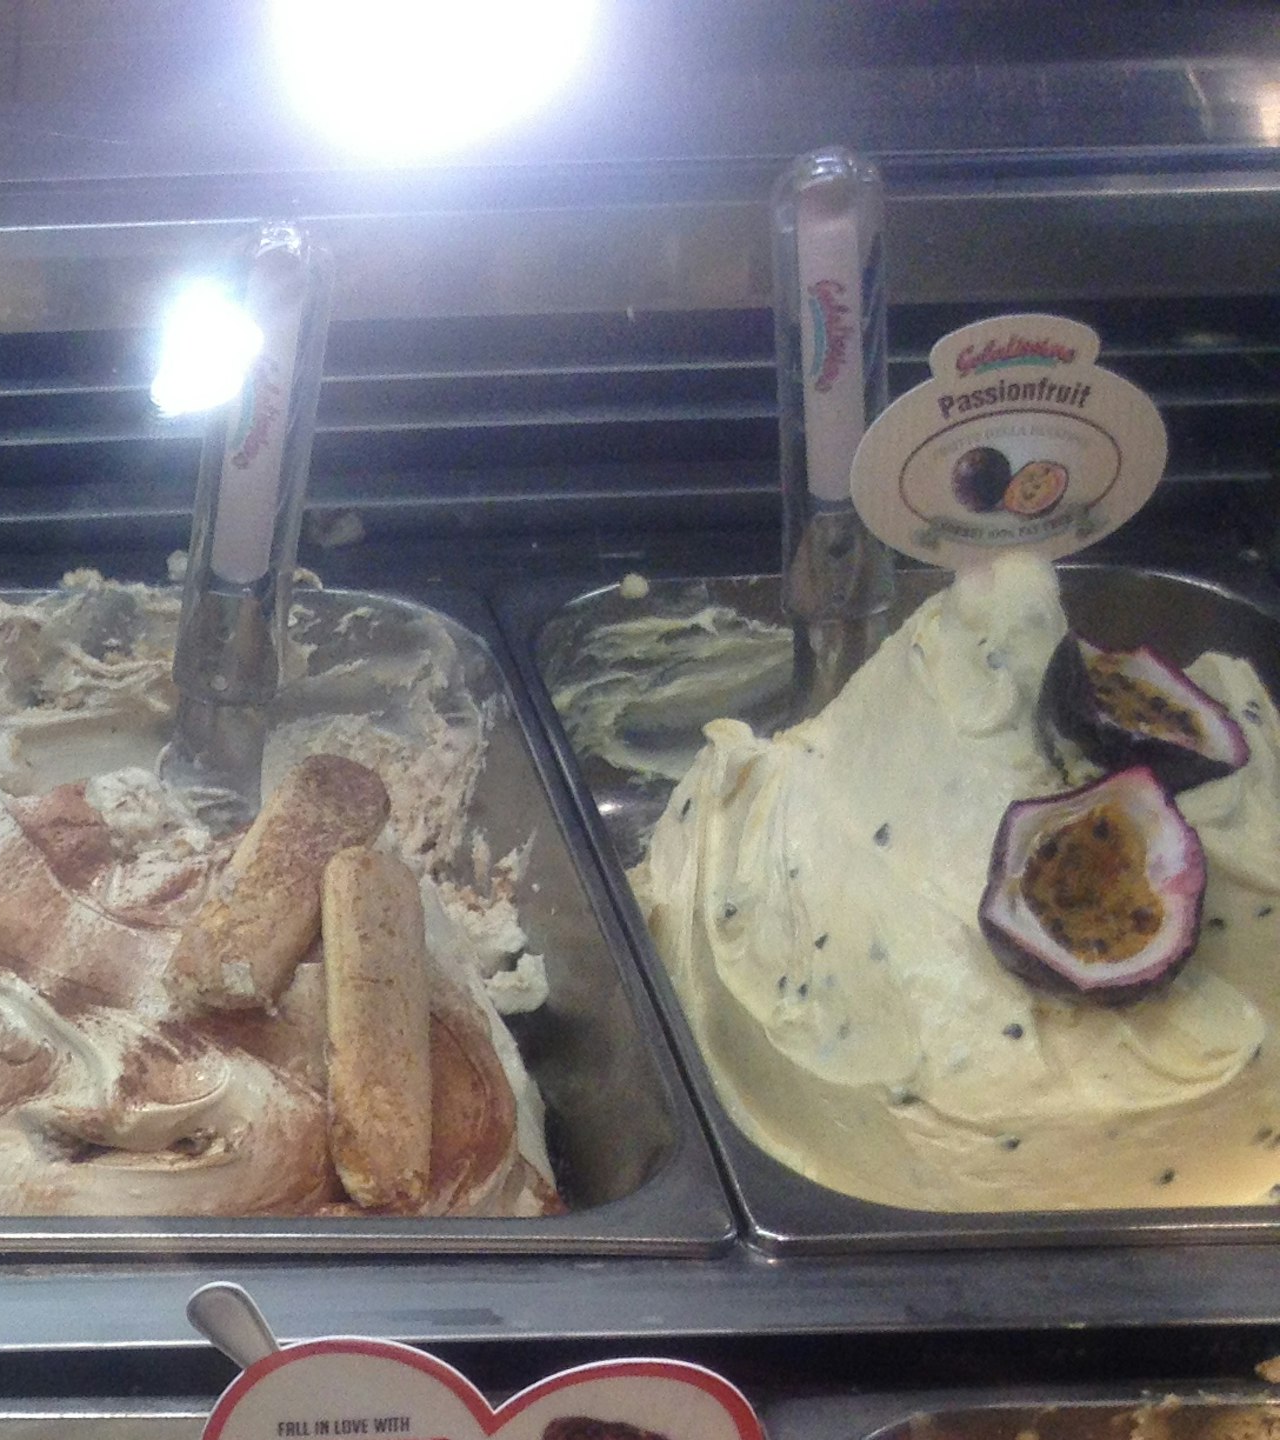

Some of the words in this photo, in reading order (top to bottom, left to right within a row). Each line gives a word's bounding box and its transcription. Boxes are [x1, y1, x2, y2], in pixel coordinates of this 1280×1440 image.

[939, 377, 1091, 419] Passionfruit
[277, 1421, 309, 1437] FALL
[314, 1420, 330, 1435] IN
[334, 1418, 369, 1435] LOVE
[374, 1417, 411, 1433] WITH
